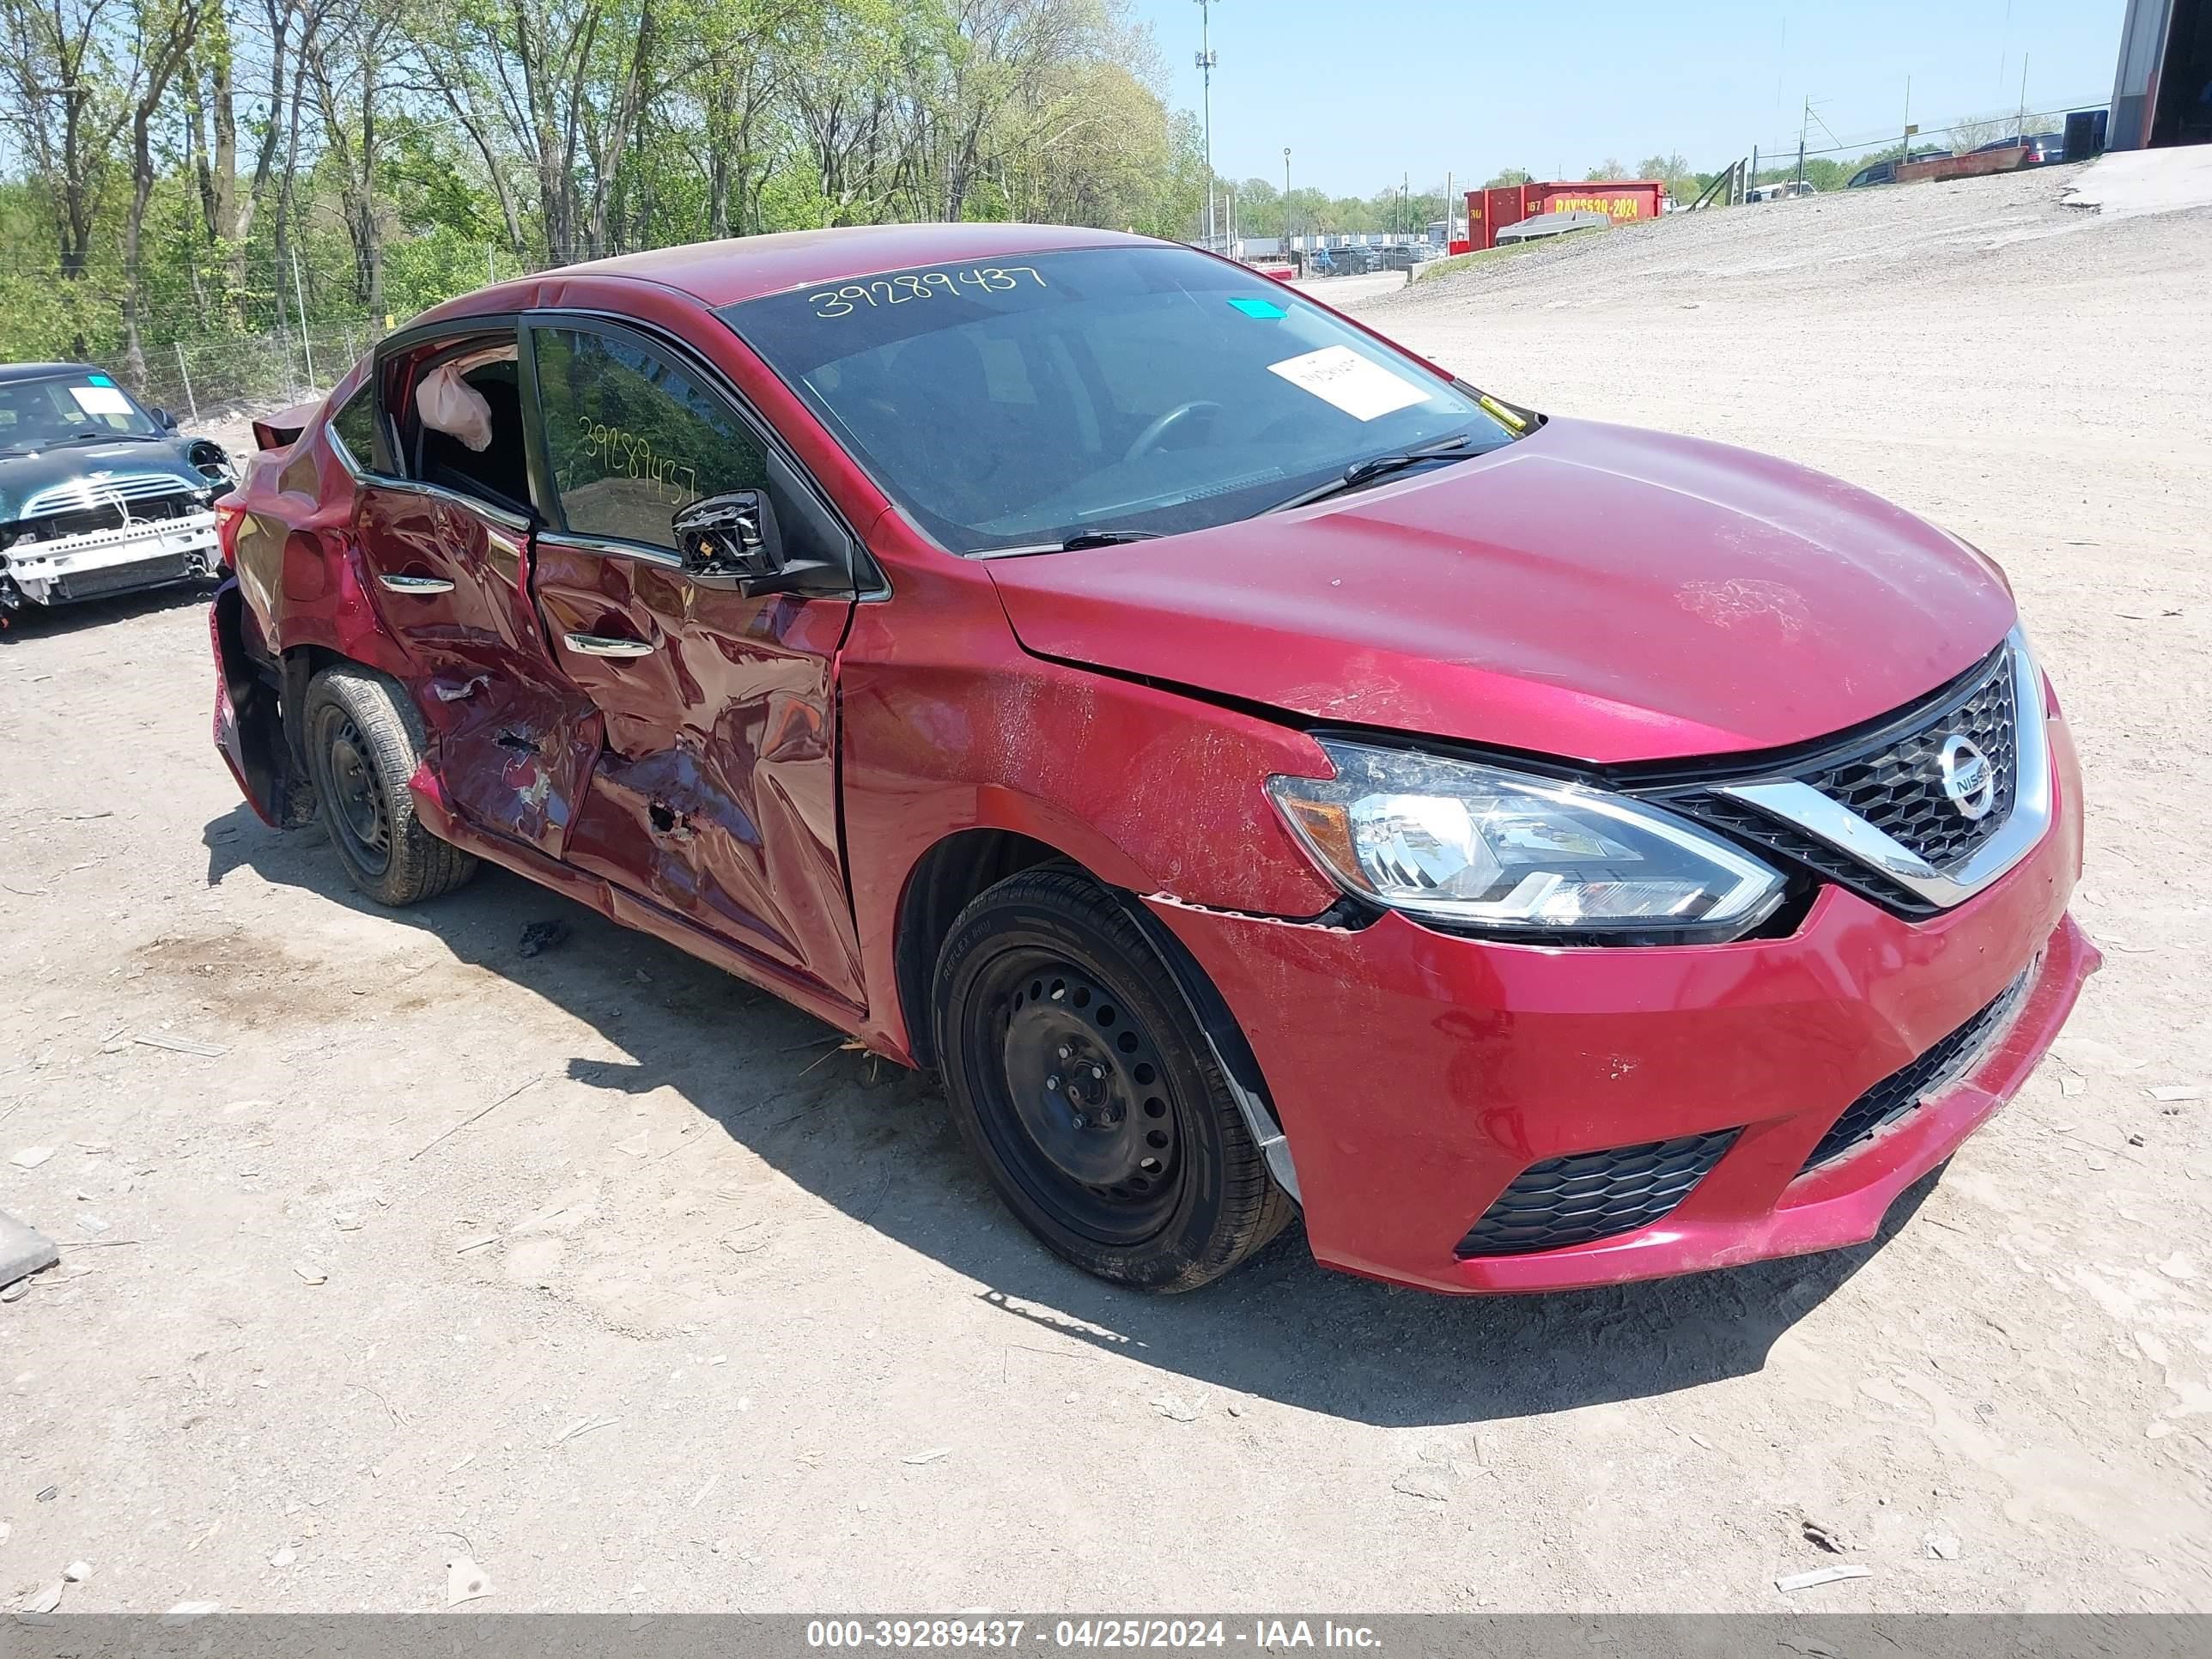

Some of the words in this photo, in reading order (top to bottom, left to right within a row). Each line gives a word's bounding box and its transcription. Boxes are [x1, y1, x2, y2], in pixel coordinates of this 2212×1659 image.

[1526, 200, 1541, 212] 167
[808, 267, 1047, 318] 39289437
[578, 416, 696, 505] 39289437
